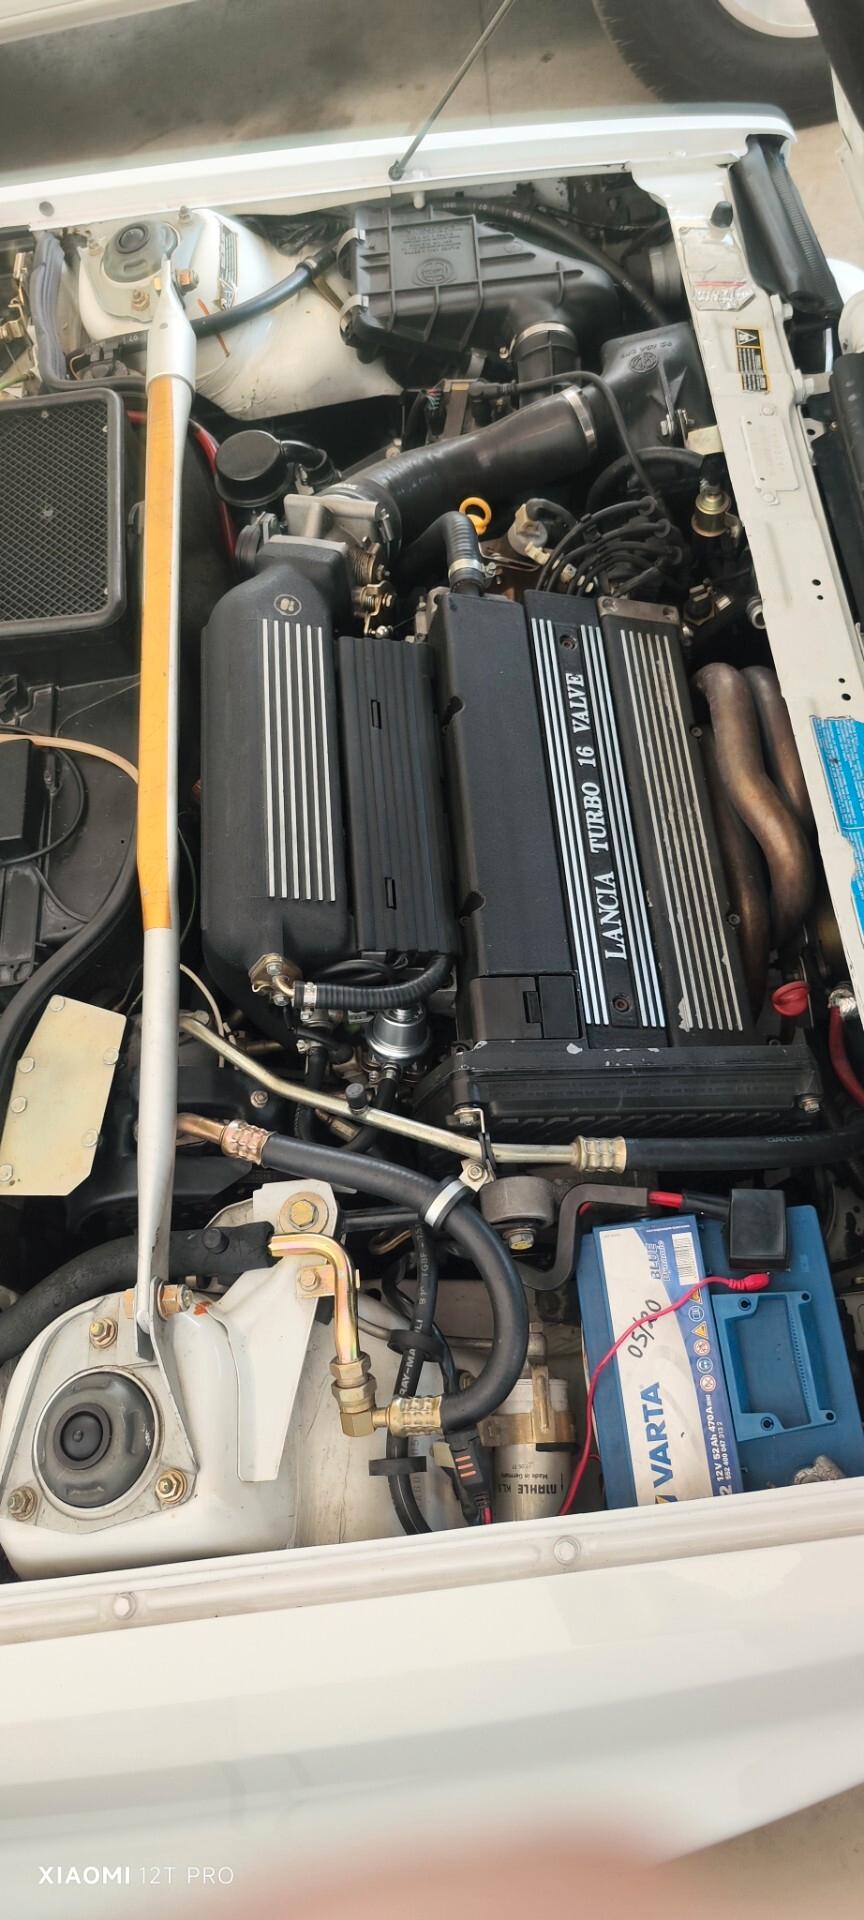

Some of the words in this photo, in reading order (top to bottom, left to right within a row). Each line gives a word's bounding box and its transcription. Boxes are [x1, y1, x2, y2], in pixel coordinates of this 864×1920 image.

[565, 672, 591, 734] VALVE
[575, 746, 597, 768] 16
[581, 782, 610, 853] TURBO
[593, 871, 628, 960] LANCIA
[648, 1243, 662, 1280] BLUE
[640, 1382, 674, 1488] VARTA
[709, 1433, 721, 1460] 52Ah
[517, 1483, 557, 1495] MAHLE
[714, 1462, 724, 1482] 12V
